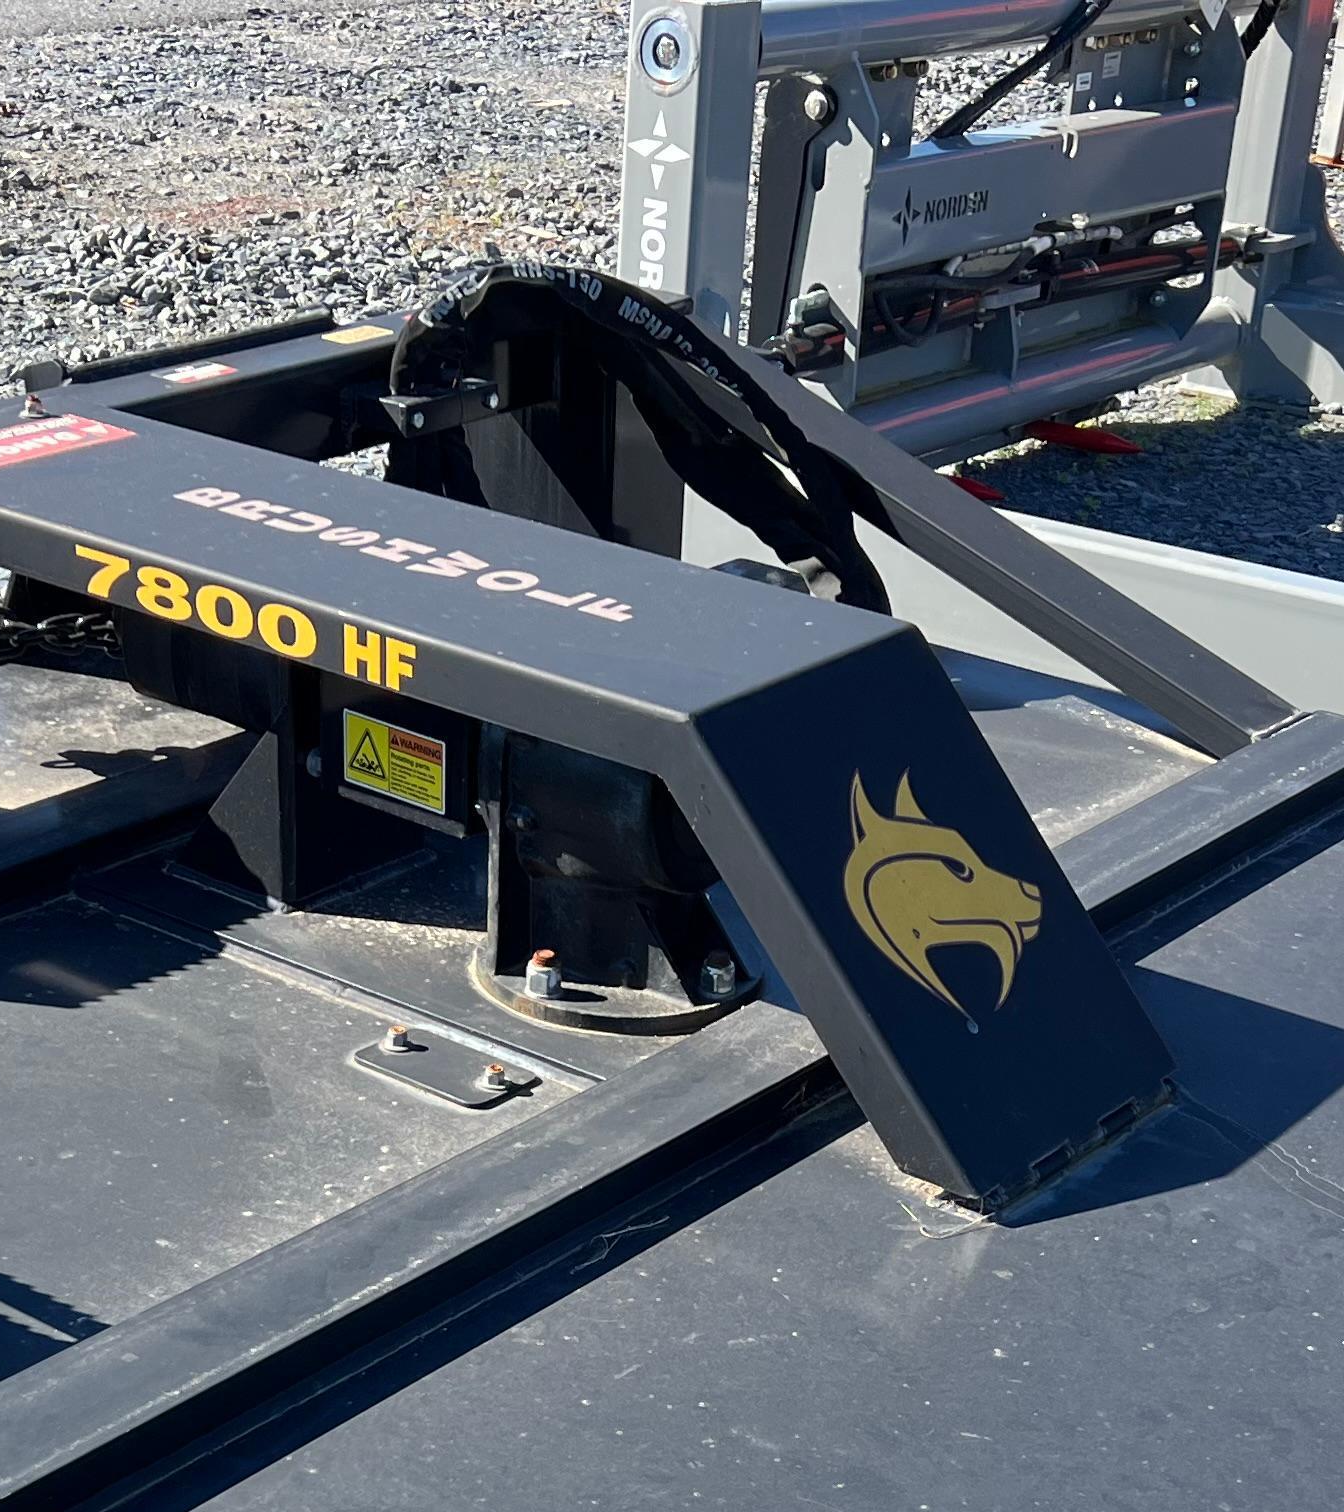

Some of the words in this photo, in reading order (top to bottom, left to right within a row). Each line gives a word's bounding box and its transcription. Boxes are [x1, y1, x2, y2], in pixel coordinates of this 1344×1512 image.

[923, 189, 989, 225] NORDEN
[638, 197, 668, 290] NOR
[75, 544, 317, 658] 7800
[343, 623, 416, 691] HF
[400, 737, 441, 759] WARNING
